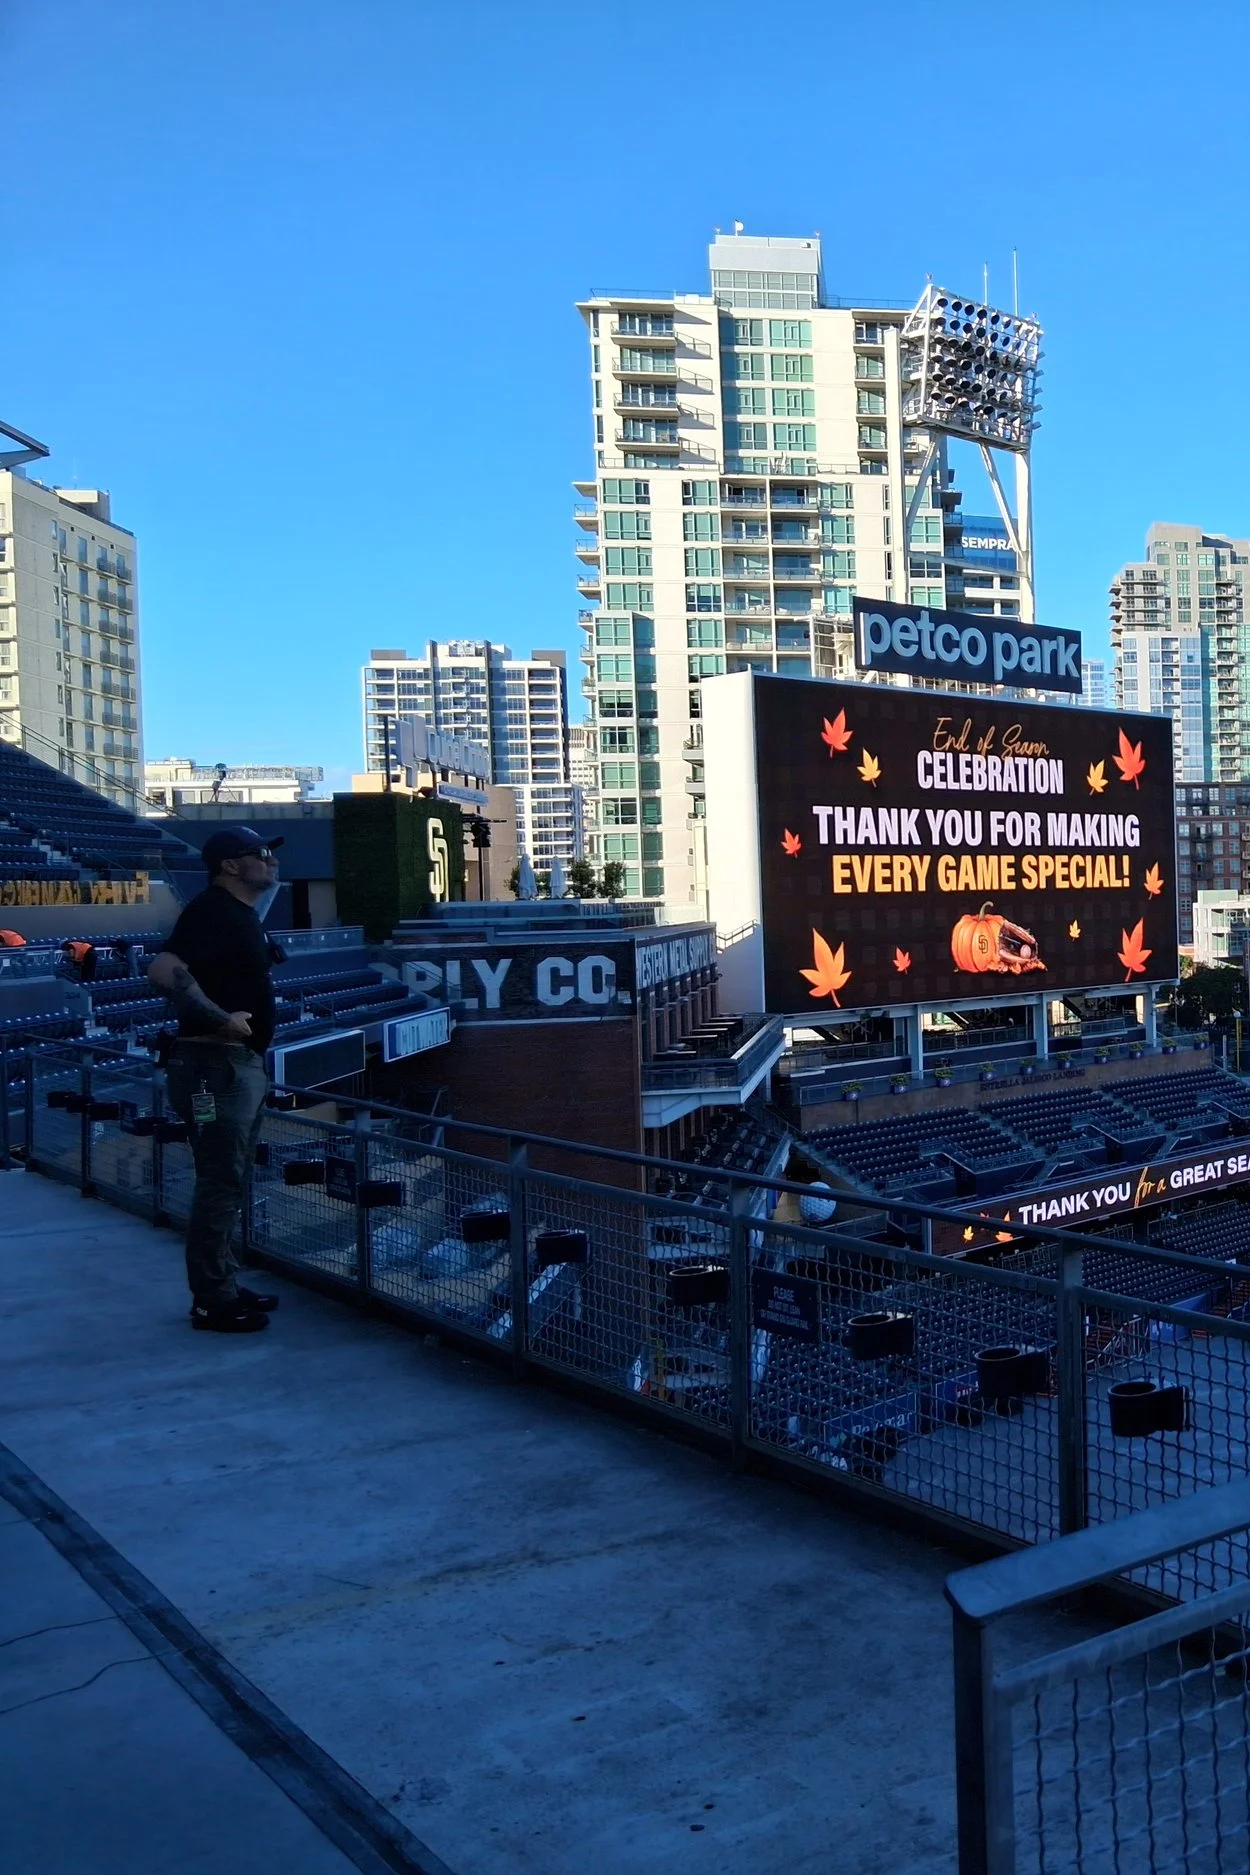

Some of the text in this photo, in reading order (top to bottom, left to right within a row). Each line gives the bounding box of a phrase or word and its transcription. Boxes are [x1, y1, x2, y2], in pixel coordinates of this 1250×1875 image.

[961, 536, 1017, 551] SEMPRA
[859, 610, 1080, 681] petco park
[932, 717, 1050, 760] End of Season
[917, 750, 1064, 794] CELEBRATION
[812, 805, 1141, 848] THANK YOU FOR MAKING
[832, 854, 1130, 894] EVERY GAME SPECIAL!
[536, 955, 632, 1006] CO.
[1018, 1192, 1090, 1225] THANK
[1093, 1181, 1131, 1208] YOU
[1133, 1167, 1156, 1209] for
[1156, 1179, 1168, 1194] a
[1170, 1160, 1223, 1189] GREAT
